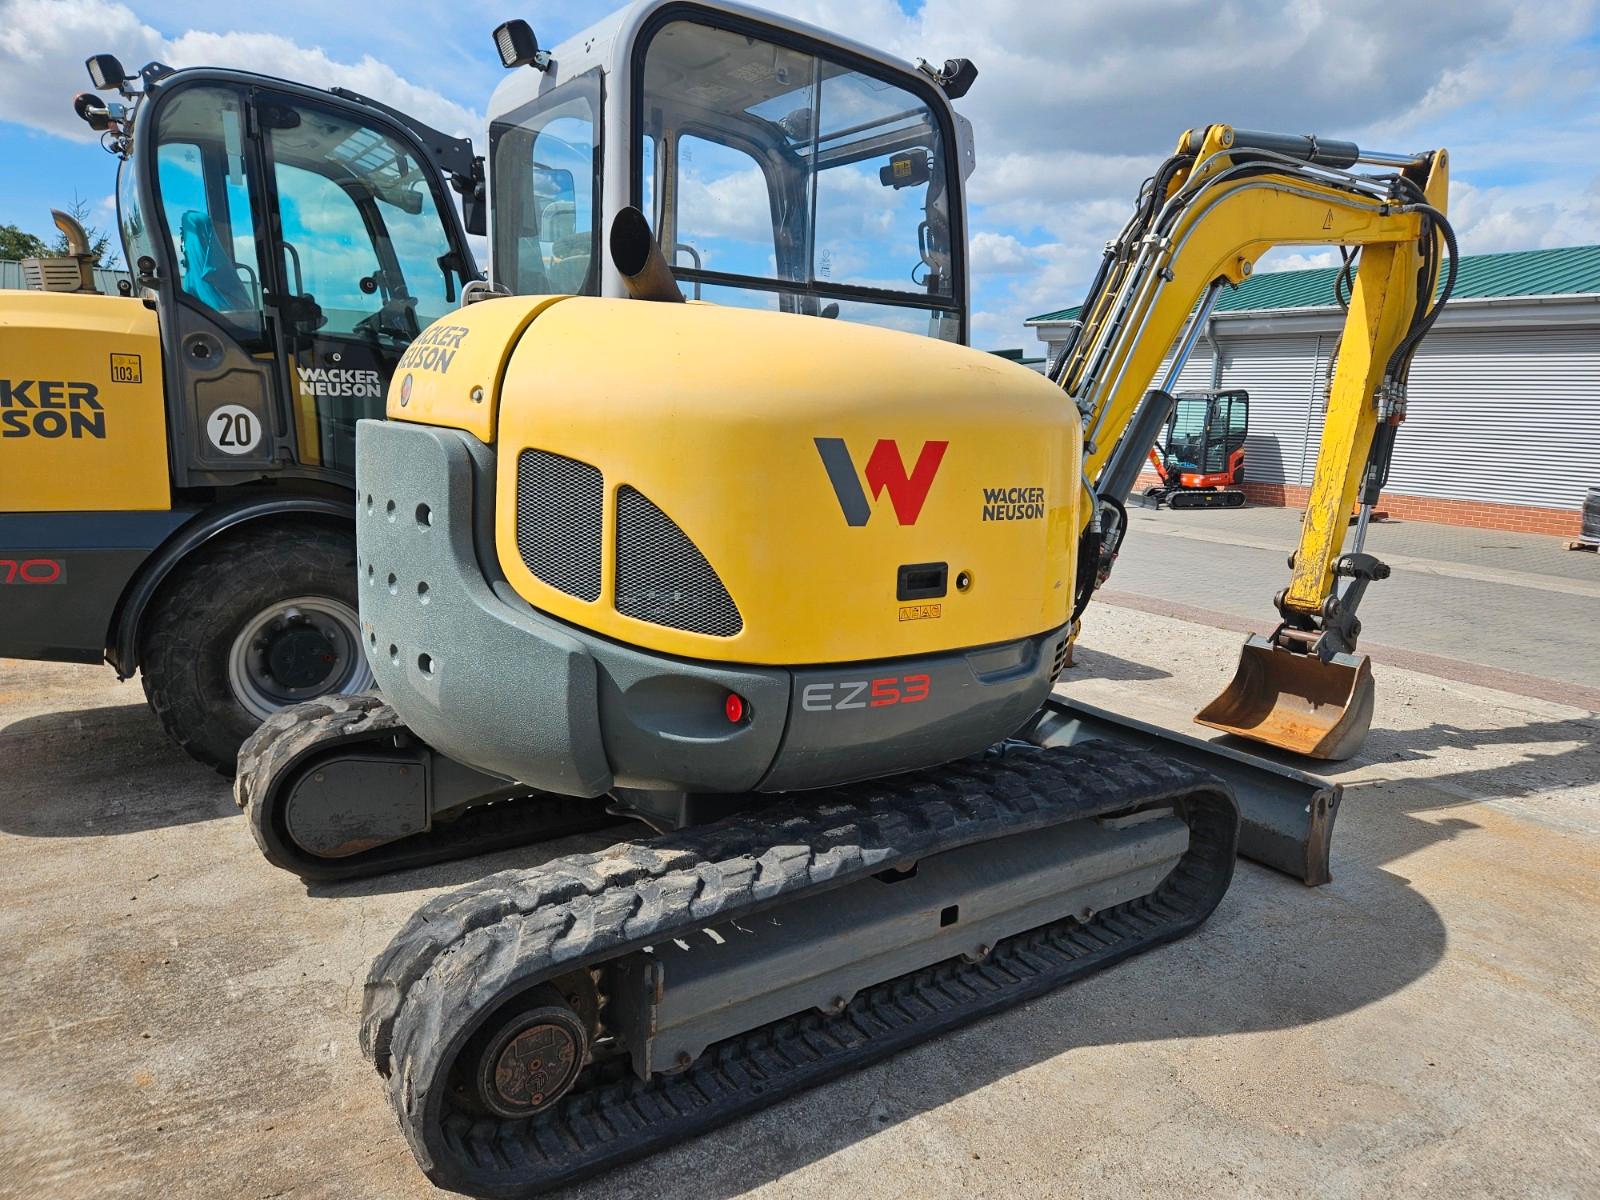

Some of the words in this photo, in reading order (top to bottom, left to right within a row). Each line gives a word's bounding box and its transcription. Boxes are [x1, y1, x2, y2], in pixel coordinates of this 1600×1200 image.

[114, 366, 133, 381] 103
[297, 367, 380, 384] WACKER
[0, 380, 104, 409] KER
[299, 381, 381, 398] NEUSON
[2, 410, 106, 439] SON
[217, 413, 251, 446] 20
[983, 487, 1045, 505] WACKER
[982, 503, 1045, 522] NEUSON
[801, 674, 931, 711] EZ53
